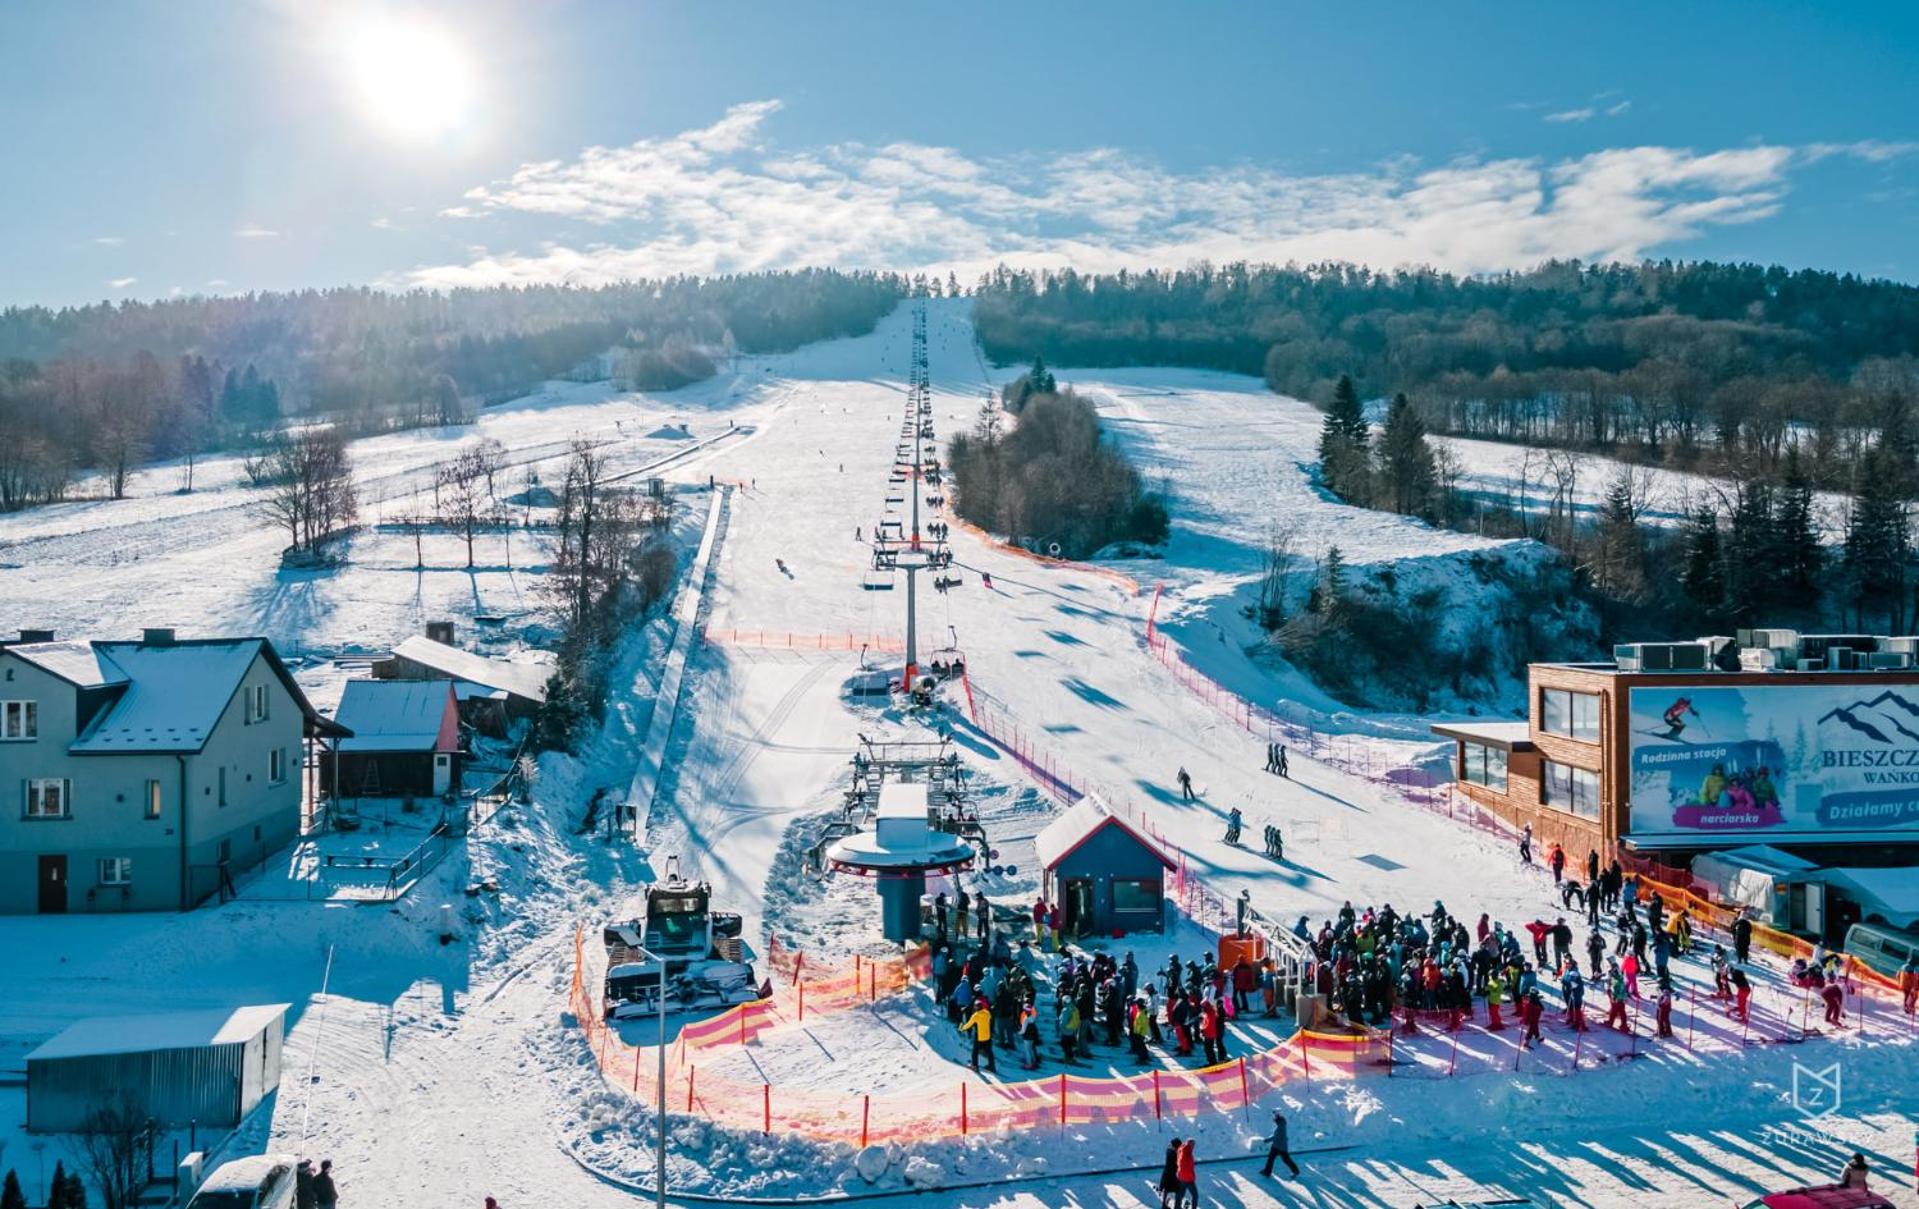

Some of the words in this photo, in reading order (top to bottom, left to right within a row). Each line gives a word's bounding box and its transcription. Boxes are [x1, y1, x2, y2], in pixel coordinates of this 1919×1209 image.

[1641, 751, 1691, 764] Rodzinna
[1693, 747, 1727, 760] stacja
[1700, 812, 1759, 824] narciarska
[1829, 801, 1903, 820] Działamy
